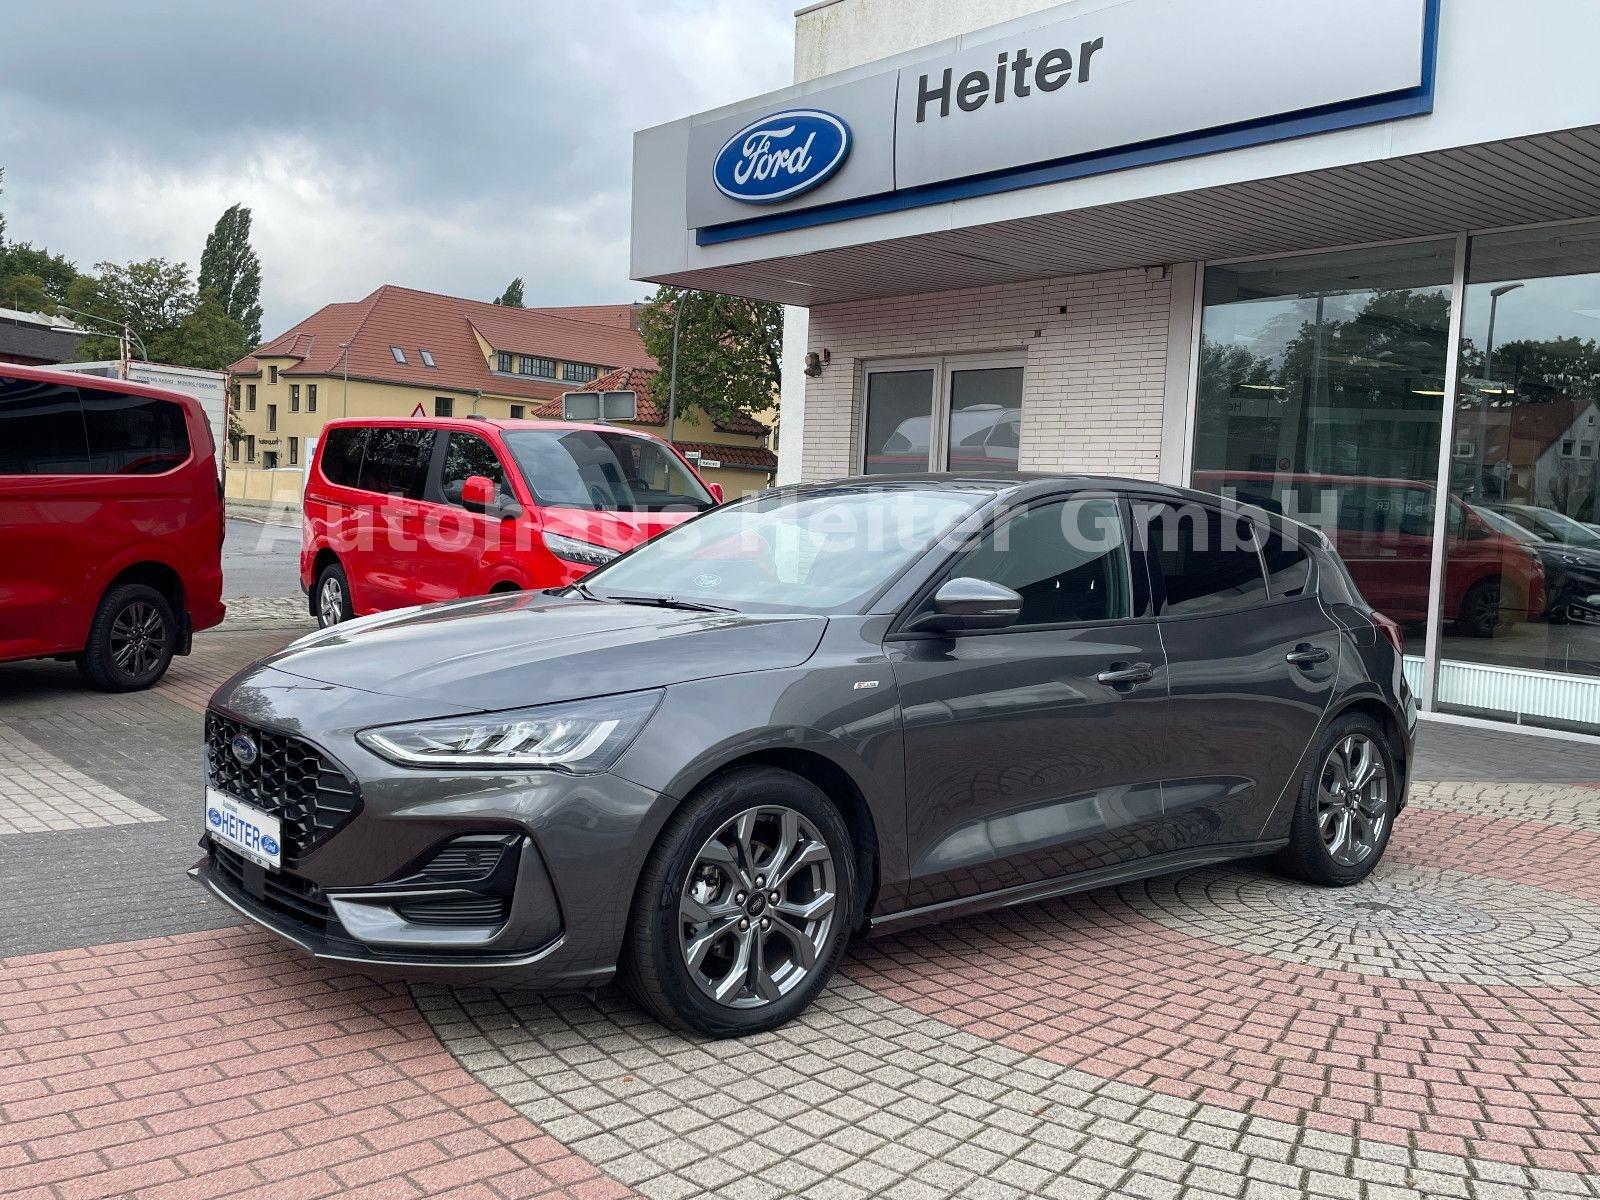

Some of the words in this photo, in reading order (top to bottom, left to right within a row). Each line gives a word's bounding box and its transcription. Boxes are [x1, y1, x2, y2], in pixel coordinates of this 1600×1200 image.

[916, 36, 1104, 123] Heiter
[734, 124, 817, 186] Ford
[222, 810, 260, 852] HEITER
[262, 836, 278, 854] Ford
